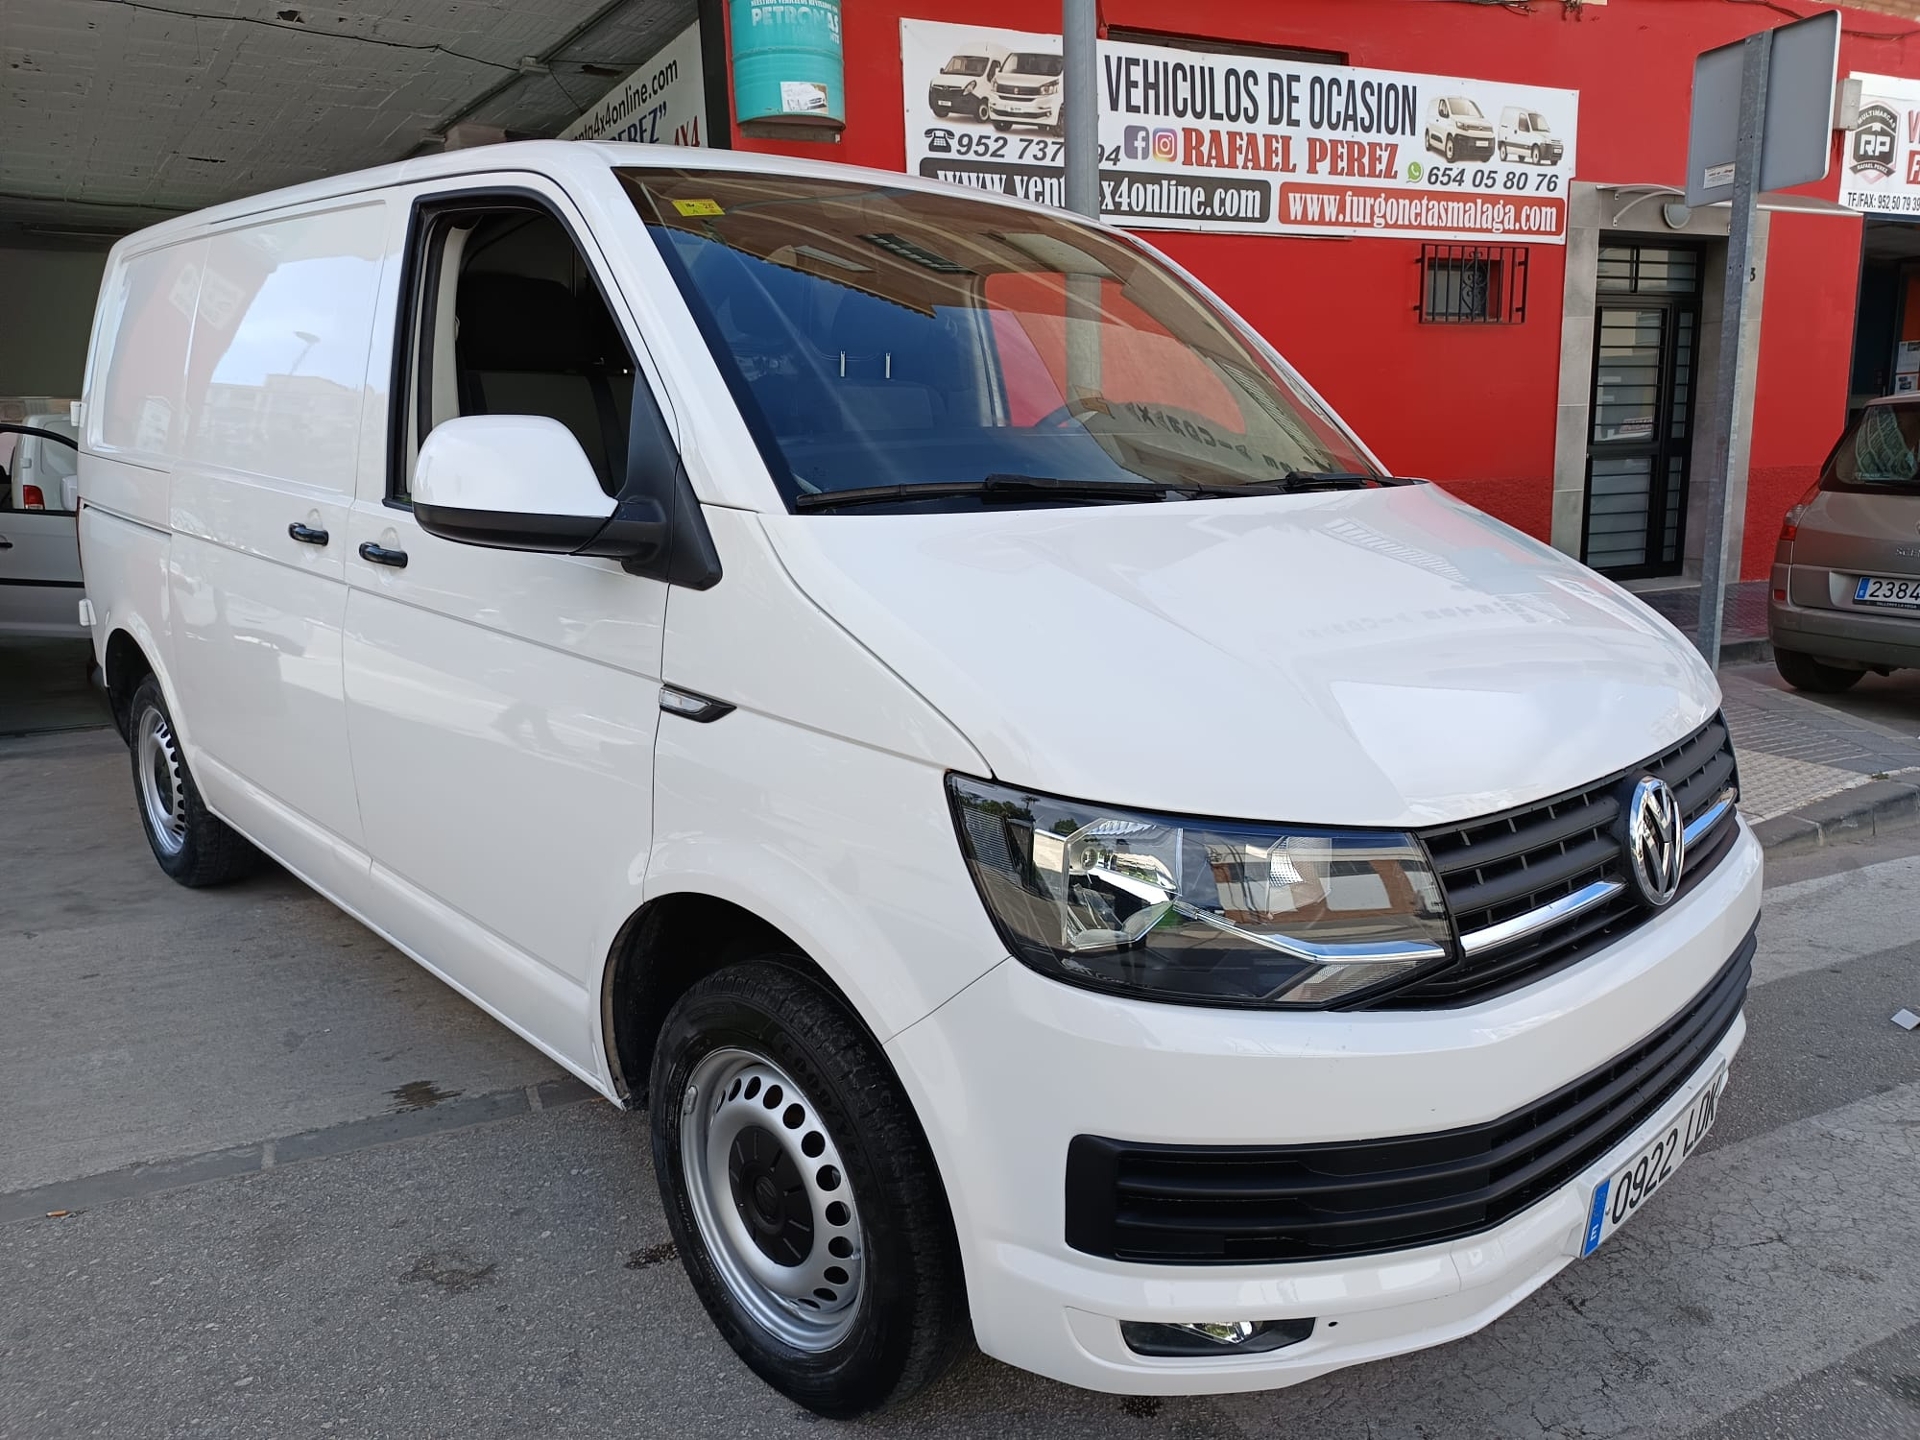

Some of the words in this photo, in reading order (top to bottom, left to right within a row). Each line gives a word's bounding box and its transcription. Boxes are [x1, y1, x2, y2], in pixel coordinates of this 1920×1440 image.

[751, 6, 839, 33] PETRONAS
[1104, 55, 1259, 124] VEHICULOS
[1268, 71, 1301, 127] DE
[1309, 76, 1417, 136] OCASION
[1857, 109, 1896, 129] MULTIMARCAS
[956, 133, 1008, 158] 952
[1018, 137, 1064, 162] 737
[1181, 127, 1297, 174] RAFAEL
[1306, 137, 1399, 180] PEREZ
[1860, 134, 1891, 156] RP
[1427, 166, 1466, 187] 654
[1472, 169, 1498, 189] 05
[1503, 171, 1529, 190] 80
[1534, 173, 1559, 192] 76
[1288, 190, 1557, 233] www.furgonetasmalaga.com
[1892, 195, 1901, 210] 50
[1902, 196, 1911, 210] 79
[1869, 581, 1920, 601] 2384
[1590, 1224, 1599, 1242] E
[1612, 1128, 1679, 1225] 0922
[1682, 1074, 1722, 1157] LDK
